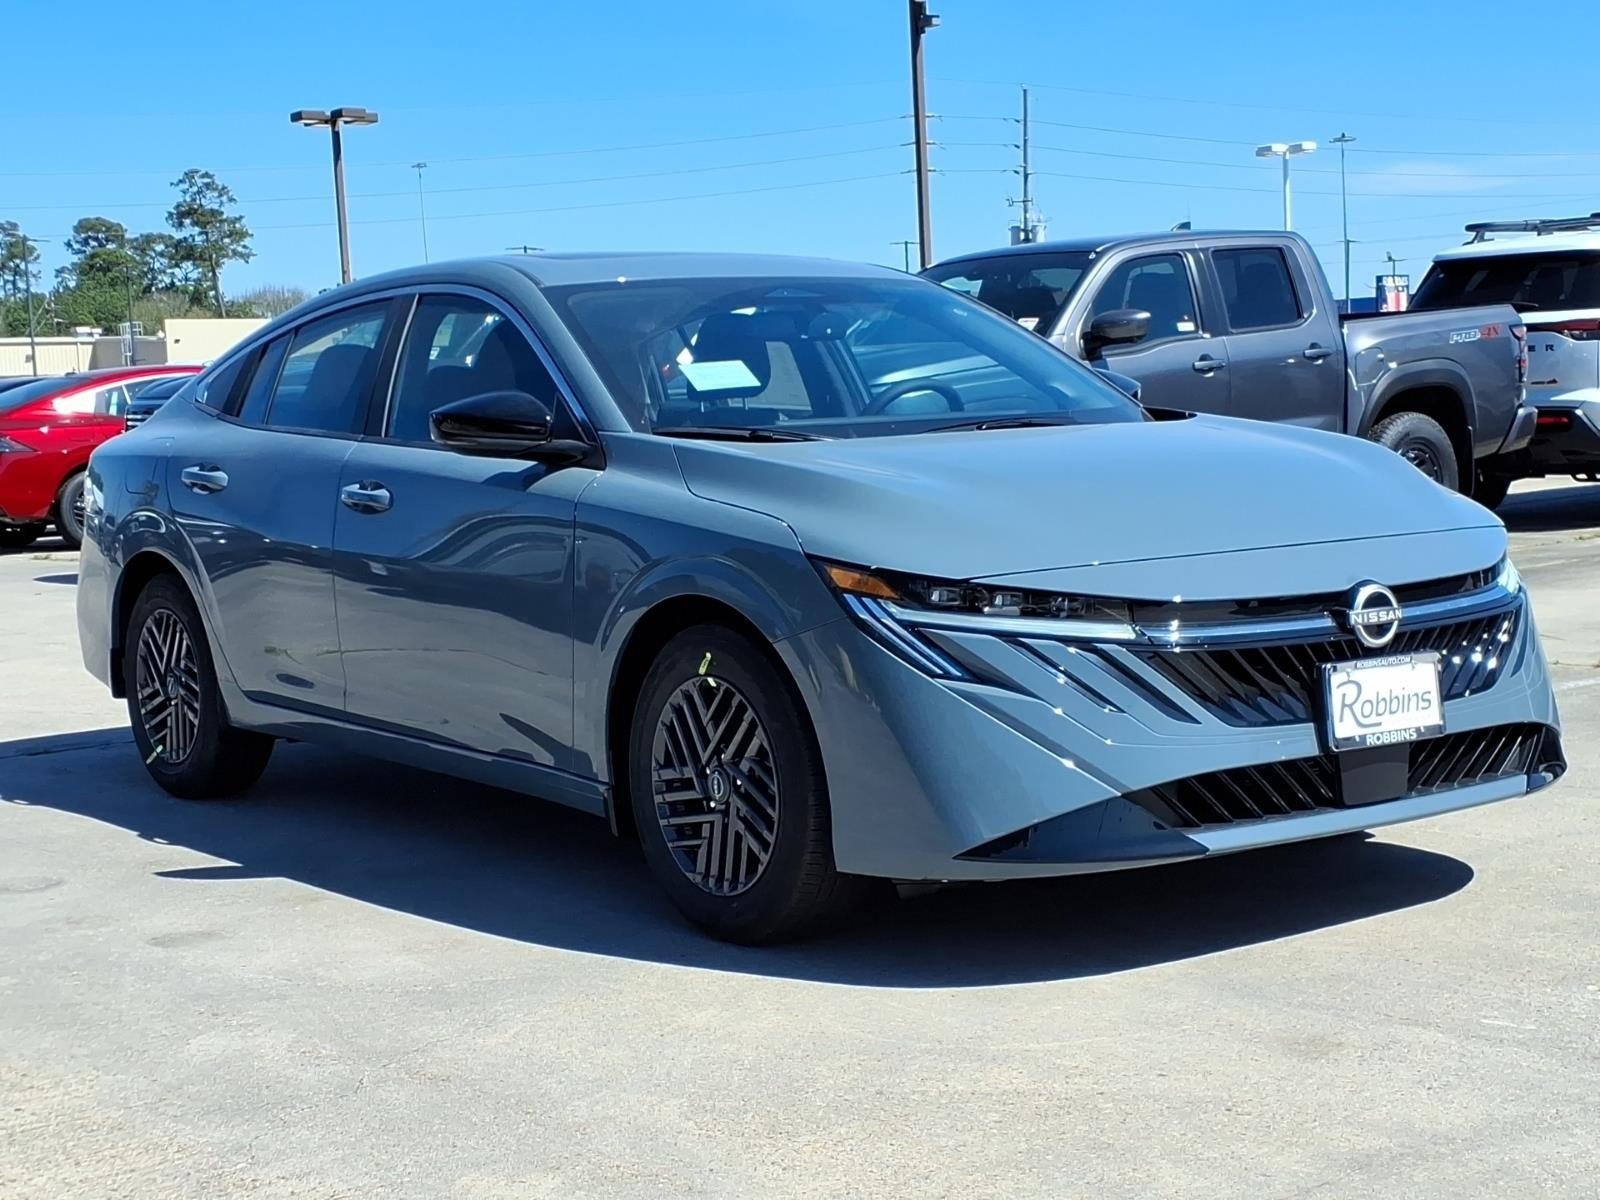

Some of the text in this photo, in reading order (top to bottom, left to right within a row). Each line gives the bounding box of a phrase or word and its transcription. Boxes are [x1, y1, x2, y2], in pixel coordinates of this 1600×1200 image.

[1351, 608, 1402, 625] NISSAN
[1336, 680, 1432, 729] Robbins
[1366, 728, 1417, 746] ROBBINS
